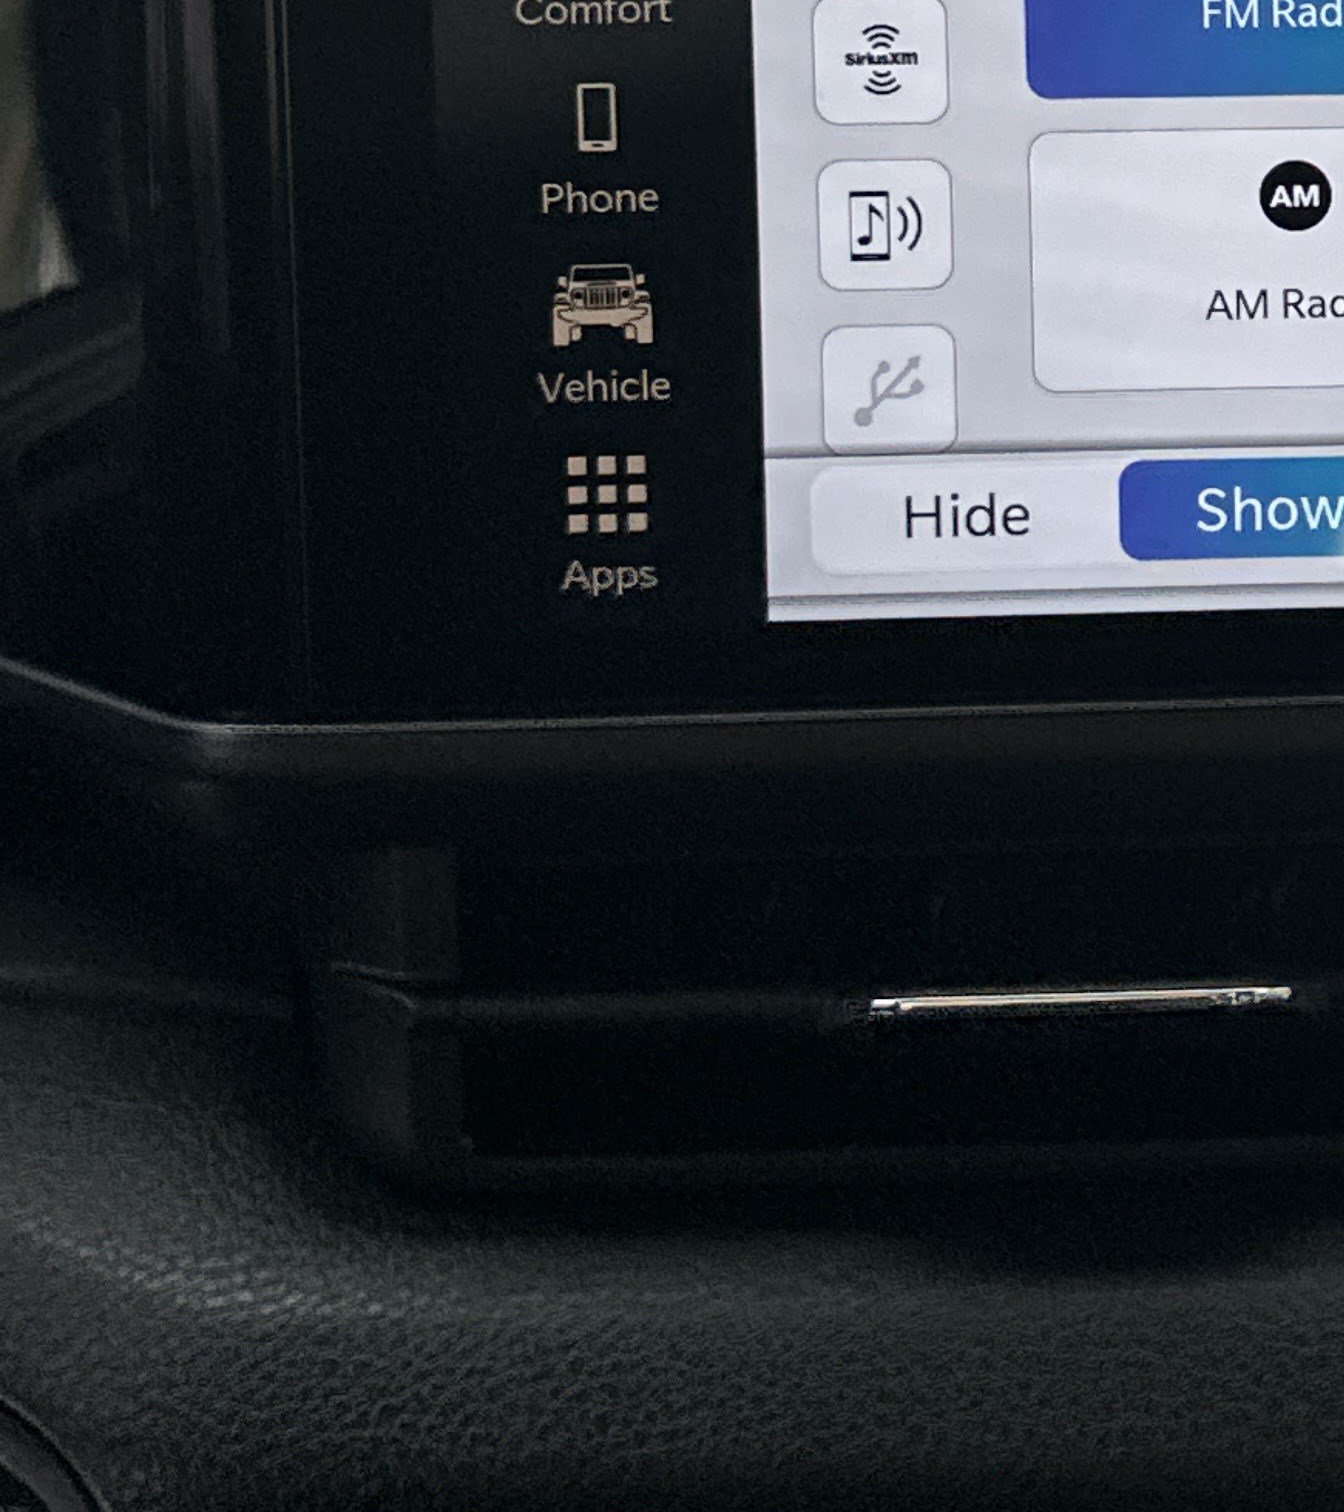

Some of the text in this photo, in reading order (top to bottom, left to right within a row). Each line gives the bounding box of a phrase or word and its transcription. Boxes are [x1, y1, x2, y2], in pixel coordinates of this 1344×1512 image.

[541, 182, 660, 214] Phone
[1269, 184, 1321, 208] AM
[1205, 291, 1270, 321] AM
[537, 370, 672, 403] Vehicle
[904, 493, 1031, 539] Hide
[560, 560, 659, 595] Apps
